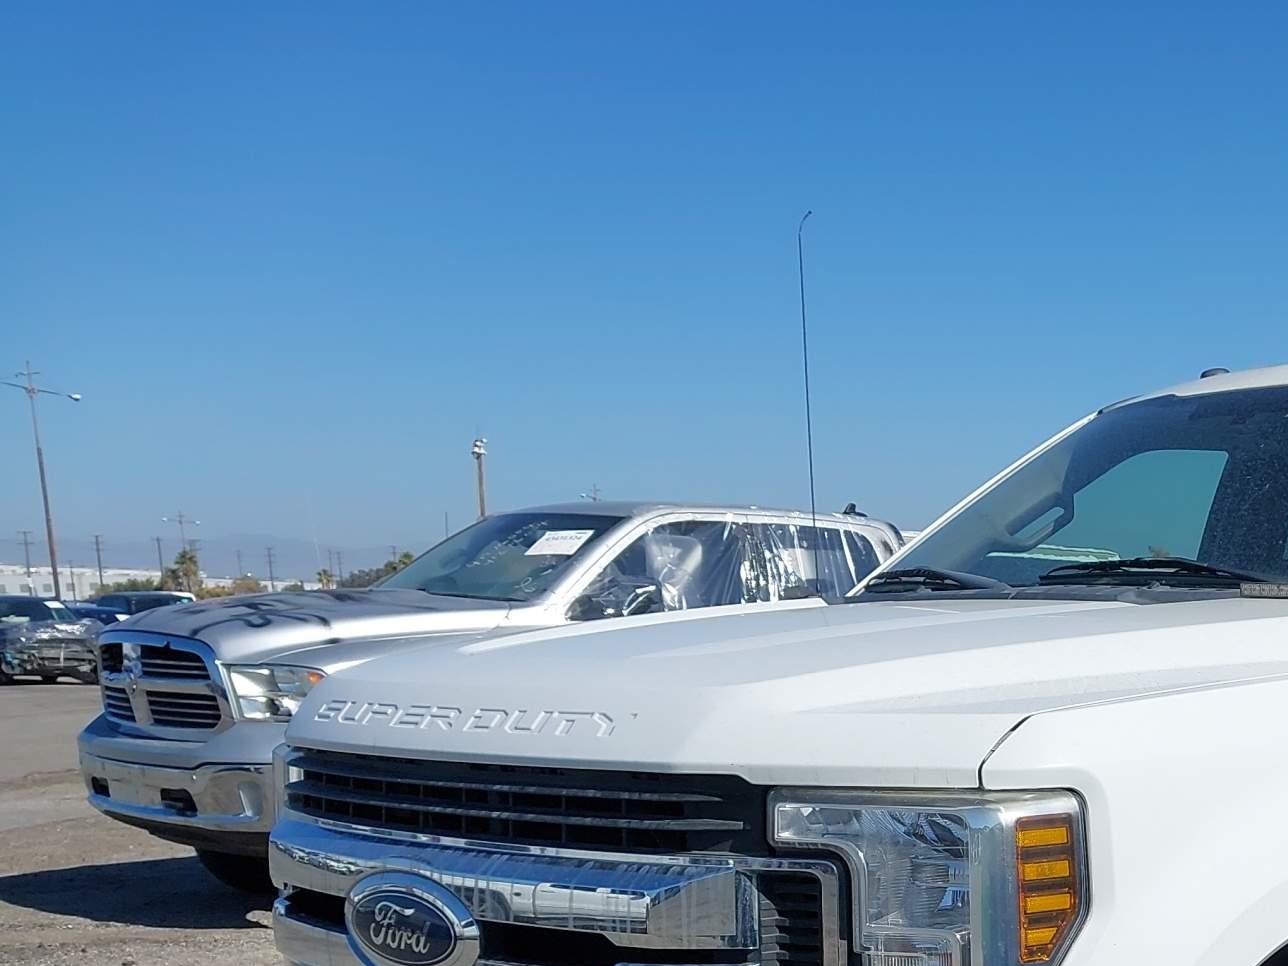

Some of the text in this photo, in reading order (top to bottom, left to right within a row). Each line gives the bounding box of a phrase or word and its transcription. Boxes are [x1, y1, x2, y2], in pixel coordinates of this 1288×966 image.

[314, 699, 616, 737] SUPER DUTY
[369, 900, 431, 955] Ford
